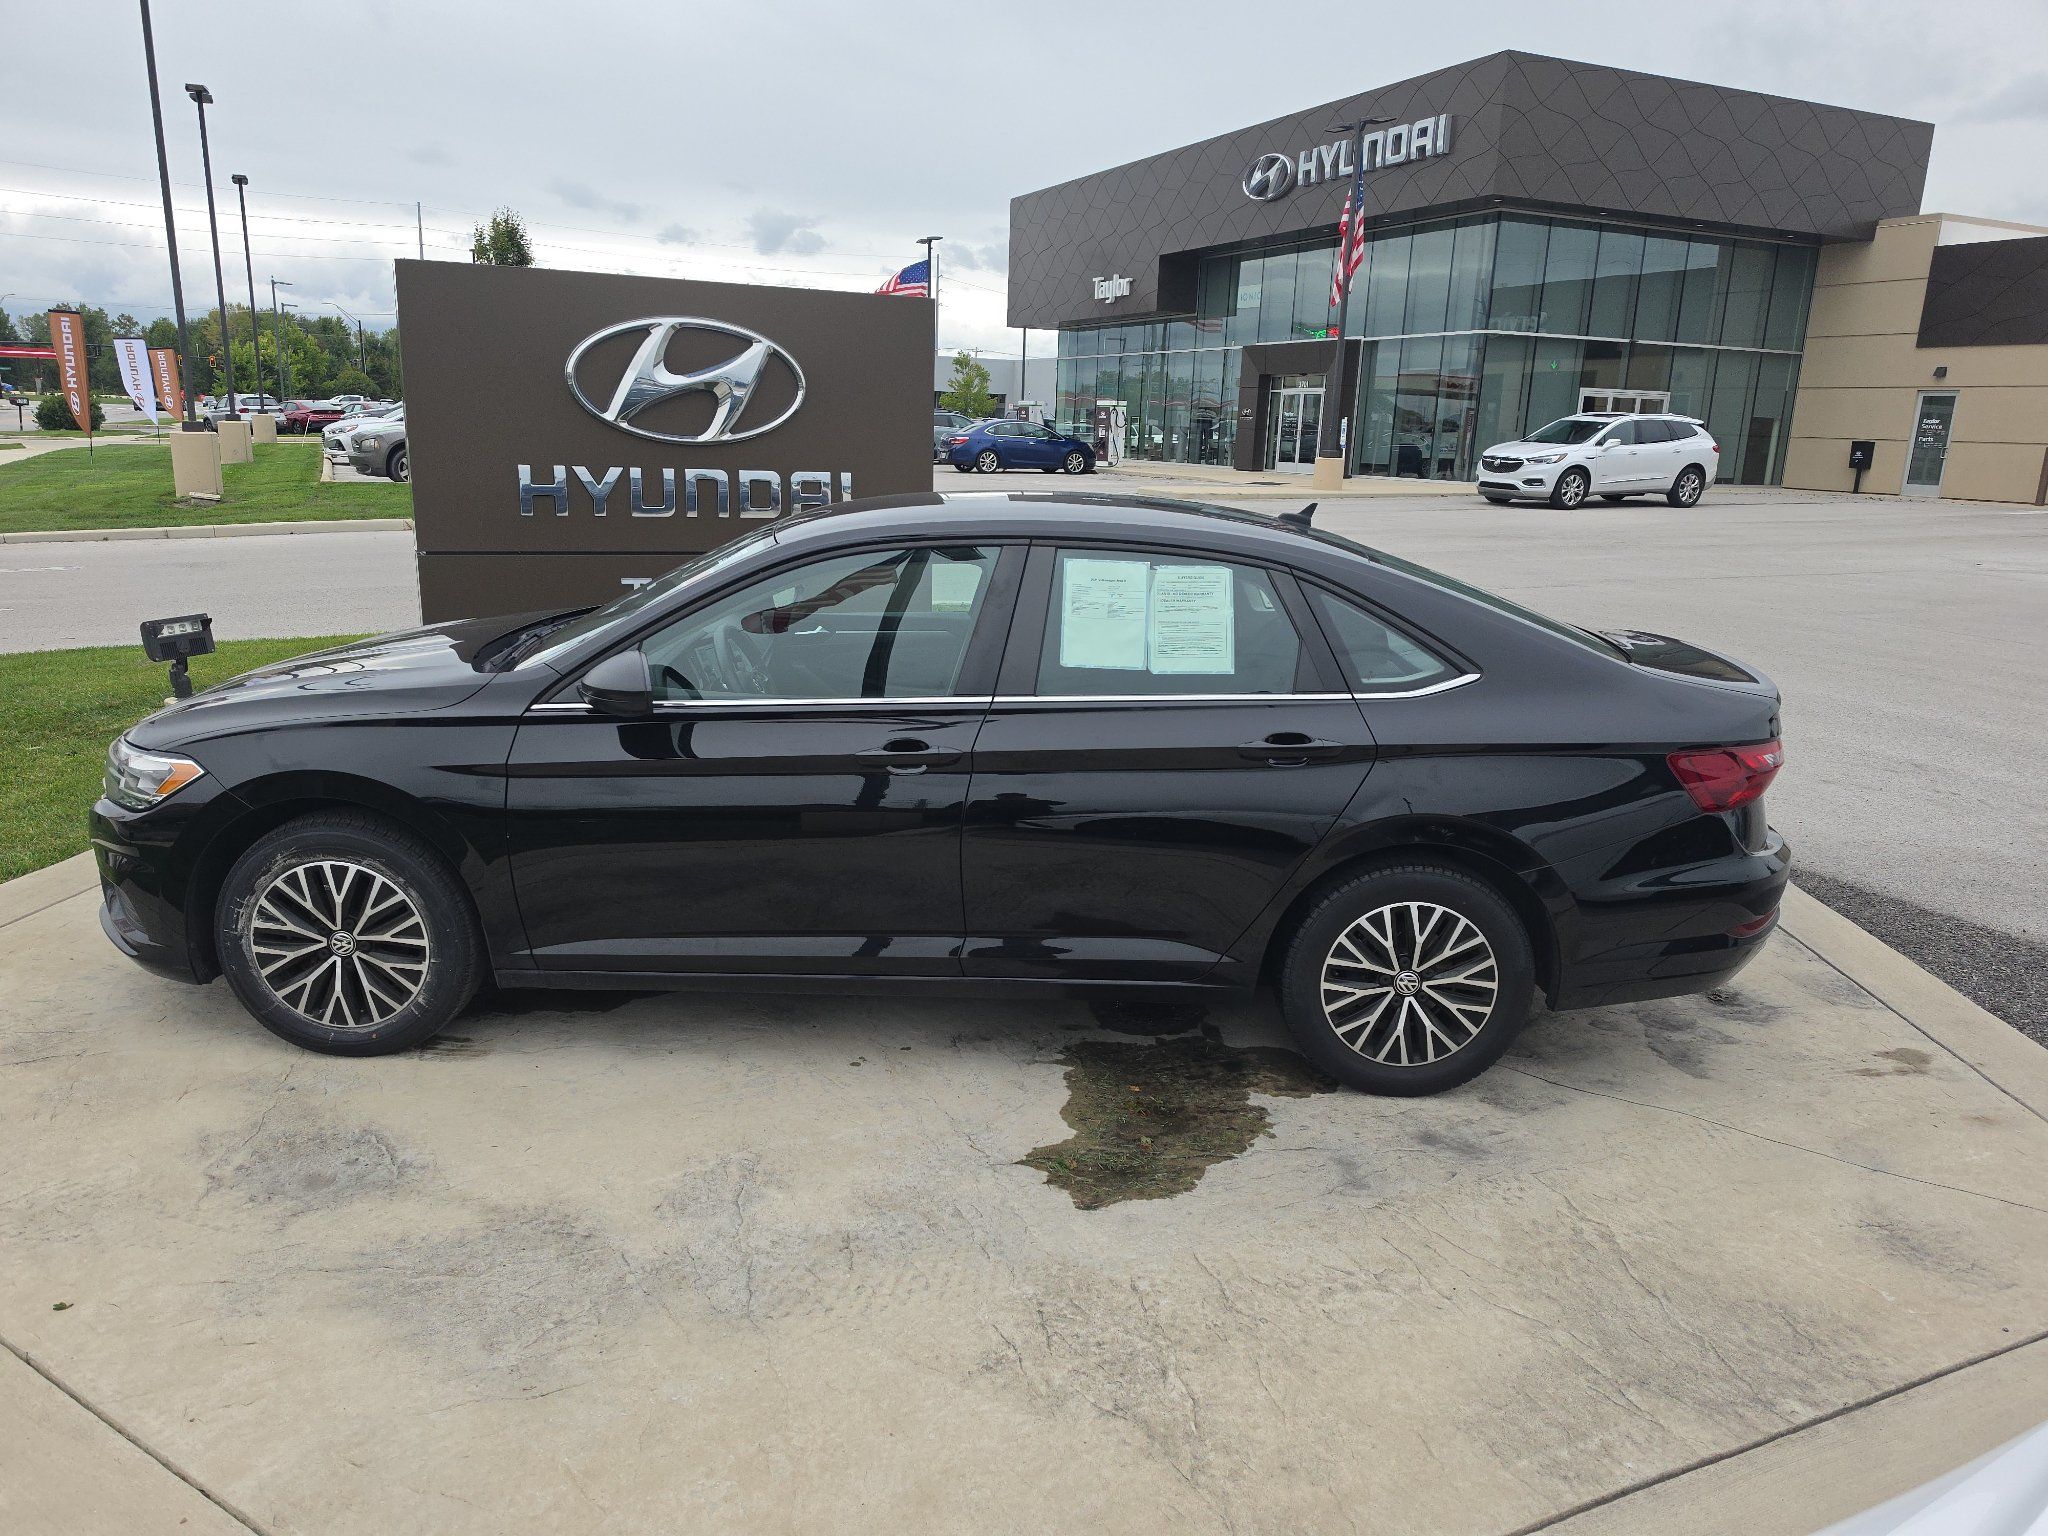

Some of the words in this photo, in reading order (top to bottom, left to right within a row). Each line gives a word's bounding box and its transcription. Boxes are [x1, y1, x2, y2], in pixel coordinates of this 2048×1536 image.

[1092, 274, 1134, 304] Taylor
[60, 317, 77, 388] HYUNDAI
[125, 342, 141, 391] HYUNDAI
[157, 351, 171, 393] HYUNDAI
[517, 464, 852, 518] HYUNDAI
